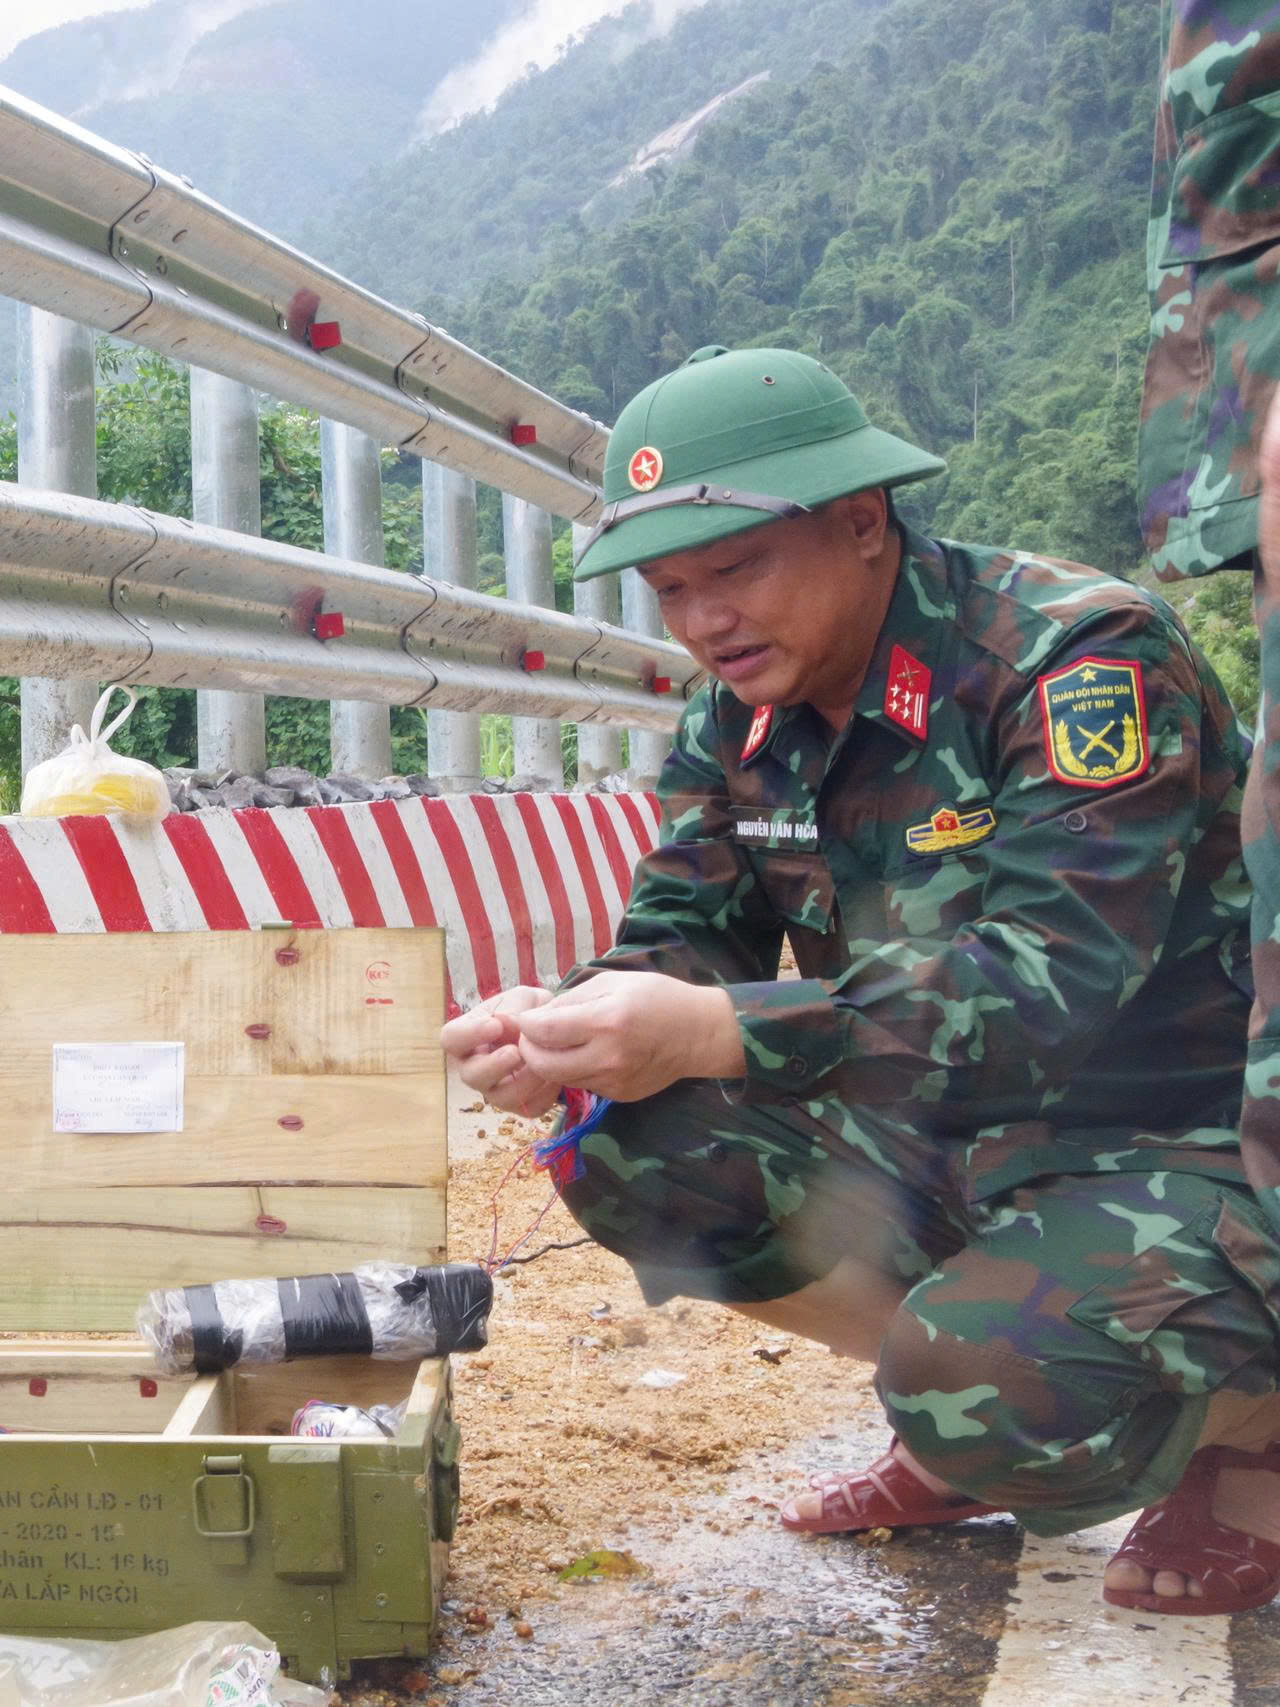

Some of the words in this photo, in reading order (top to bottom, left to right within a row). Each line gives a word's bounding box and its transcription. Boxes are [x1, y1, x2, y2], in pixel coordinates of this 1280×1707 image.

[1091, 685, 1113, 695] NHÂN
[1114, 684, 1130, 694] DÂN
[1072, 701, 1092, 713] VIỆT
[1095, 700, 1114, 709] NAM
[770, 820, 793, 839] VĂN
[87, 1492, 117, 1510] LĐ
[139, 1493, 163, 1511] 01
[16, 1522, 68, 1541] 2020
[64, 1551, 102, 1570] KL:
[142, 1553, 169, 1577] kg
